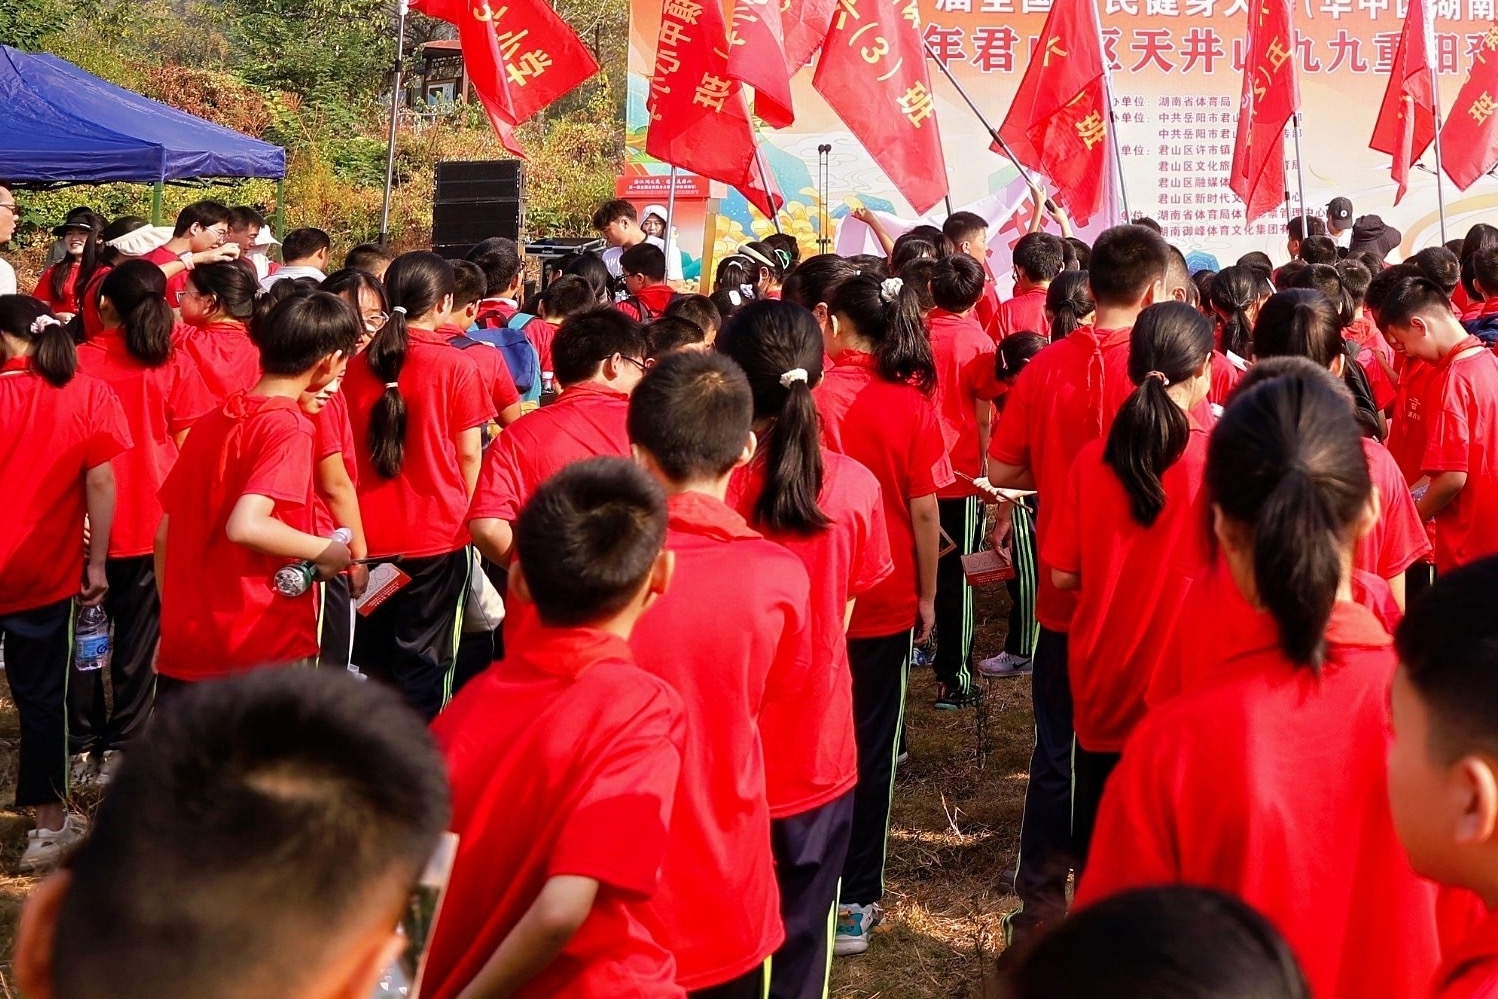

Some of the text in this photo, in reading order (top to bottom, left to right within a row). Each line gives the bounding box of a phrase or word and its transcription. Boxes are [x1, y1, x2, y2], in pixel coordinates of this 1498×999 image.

[1158, 96, 1231, 107] 湖南省体育局
